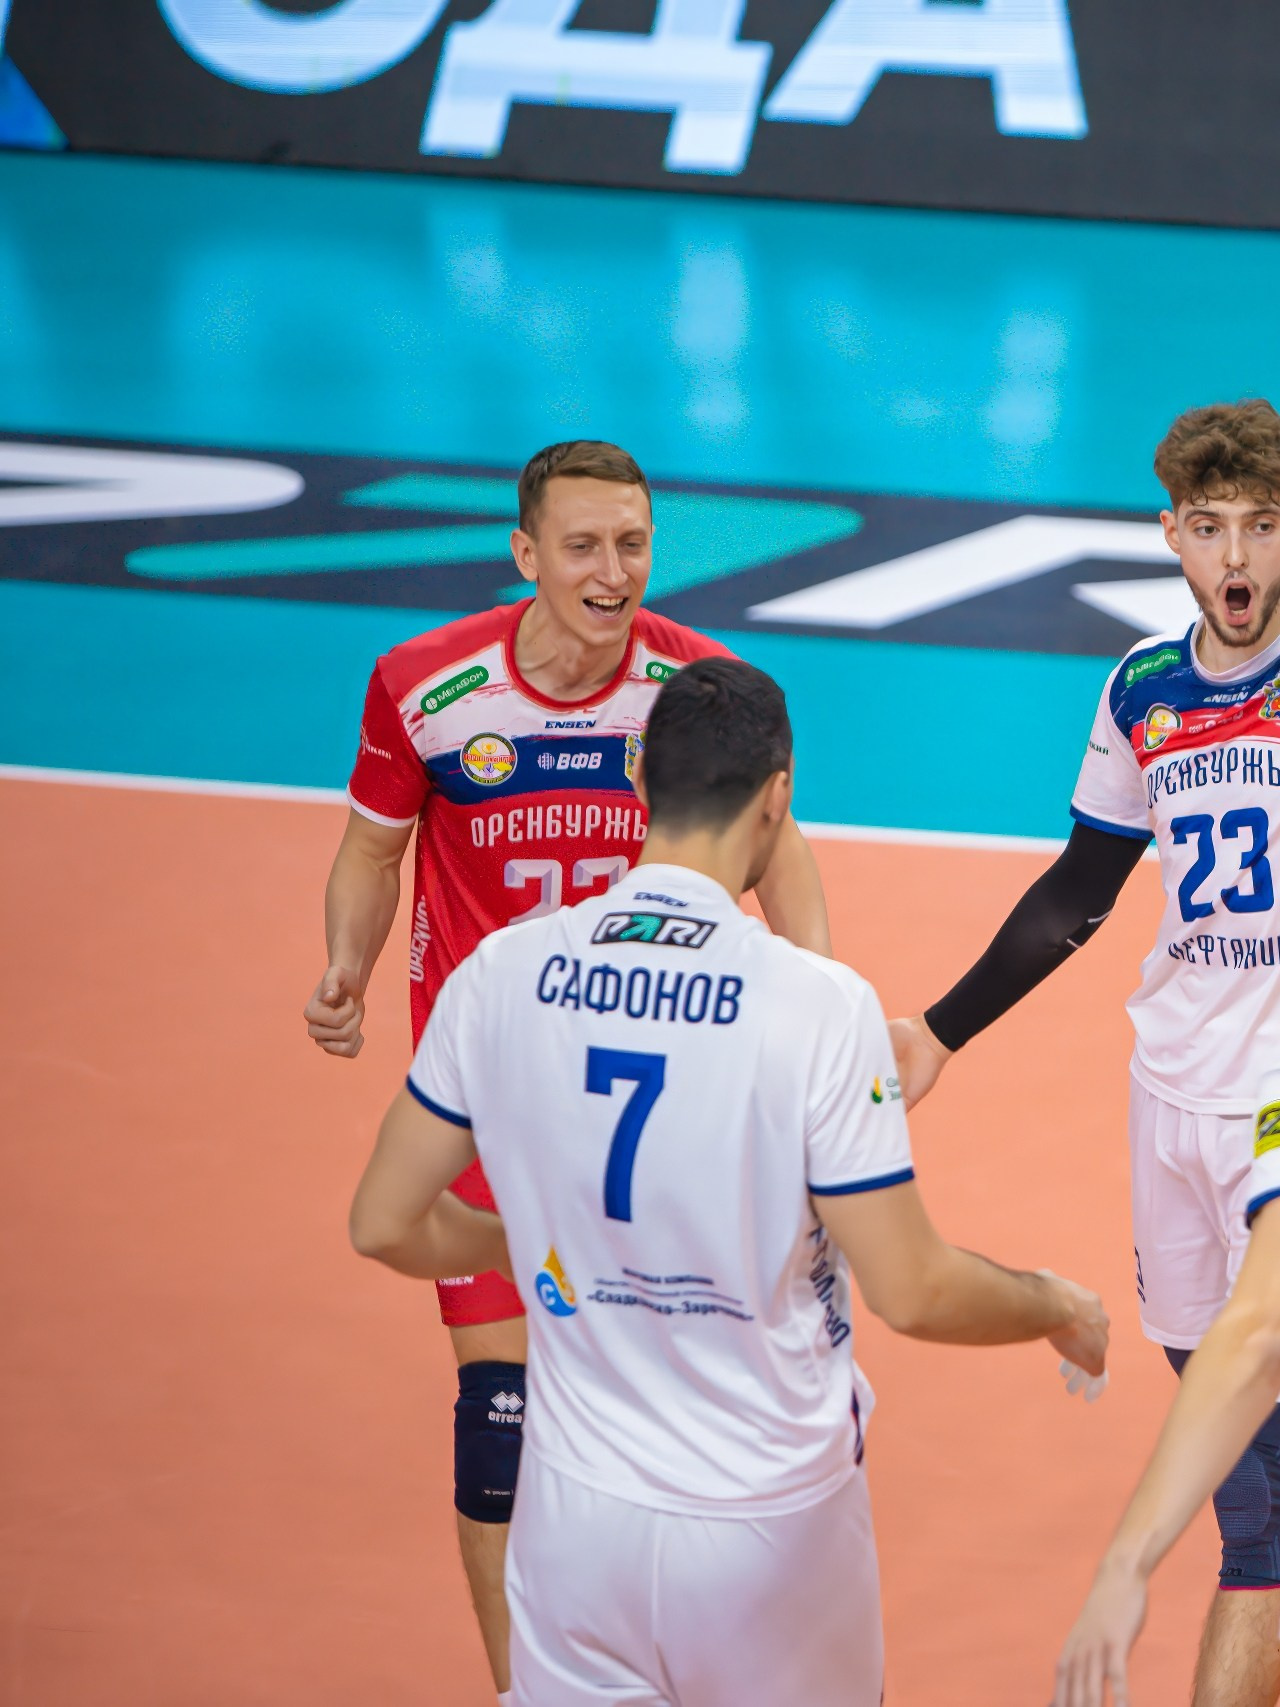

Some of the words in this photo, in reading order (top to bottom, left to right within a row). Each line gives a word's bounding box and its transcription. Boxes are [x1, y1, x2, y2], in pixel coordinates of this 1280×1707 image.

[436, 670, 485, 702] МЕГАФОН
[544, 720, 597, 729] ENSEN
[556, 752, 603, 770] ВФВ
[470, 799, 649, 848] ОРЕНБУРЖЬ
[1169, 806, 1275, 923] 23
[592, 913, 714, 948] PARI
[536, 953, 744, 1025] САФОНОВ
[585, 1045, 667, 1223] 7
